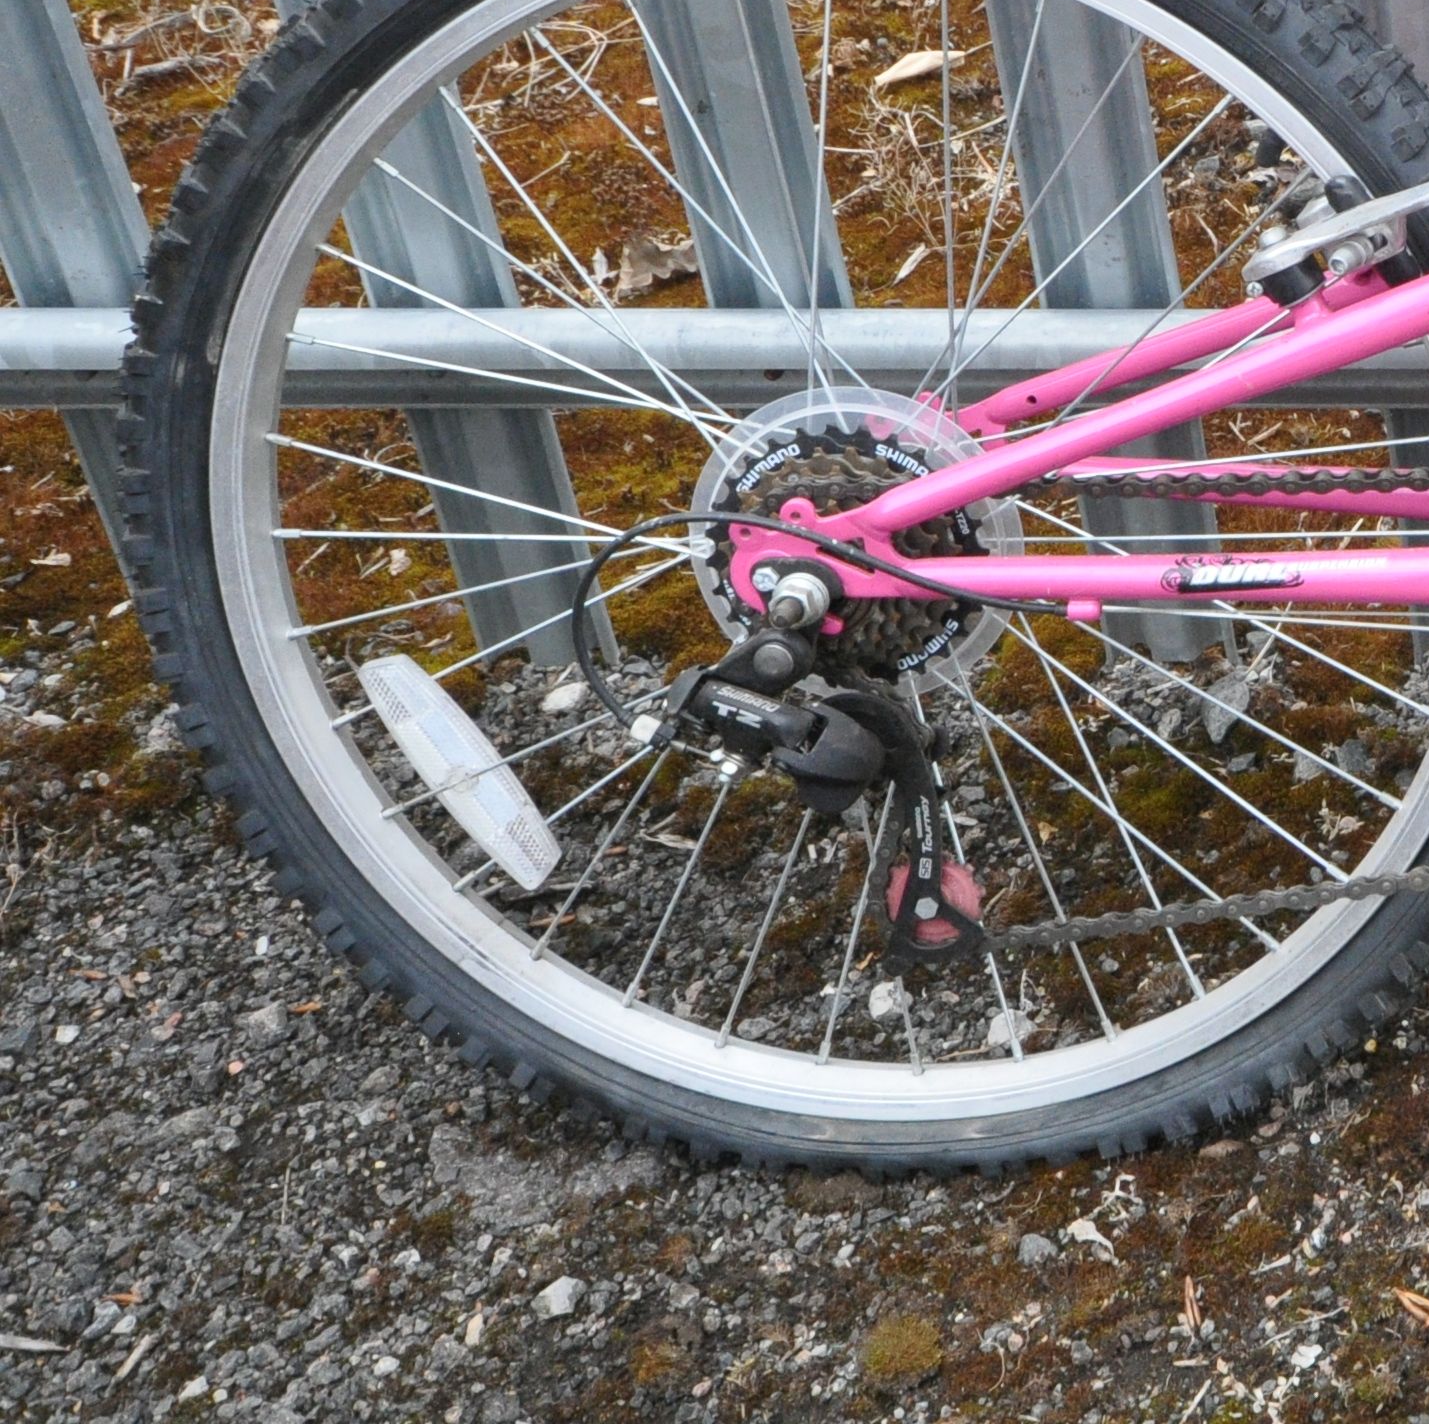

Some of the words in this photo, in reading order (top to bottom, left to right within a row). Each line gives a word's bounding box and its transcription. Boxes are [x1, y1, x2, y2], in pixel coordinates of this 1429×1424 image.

[736, 444, 801, 493] SHIMANO
[712, 700, 762, 729] TZ
[717, 685, 781, 713] SHIMANO
[920, 795, 933, 854] Tourney
